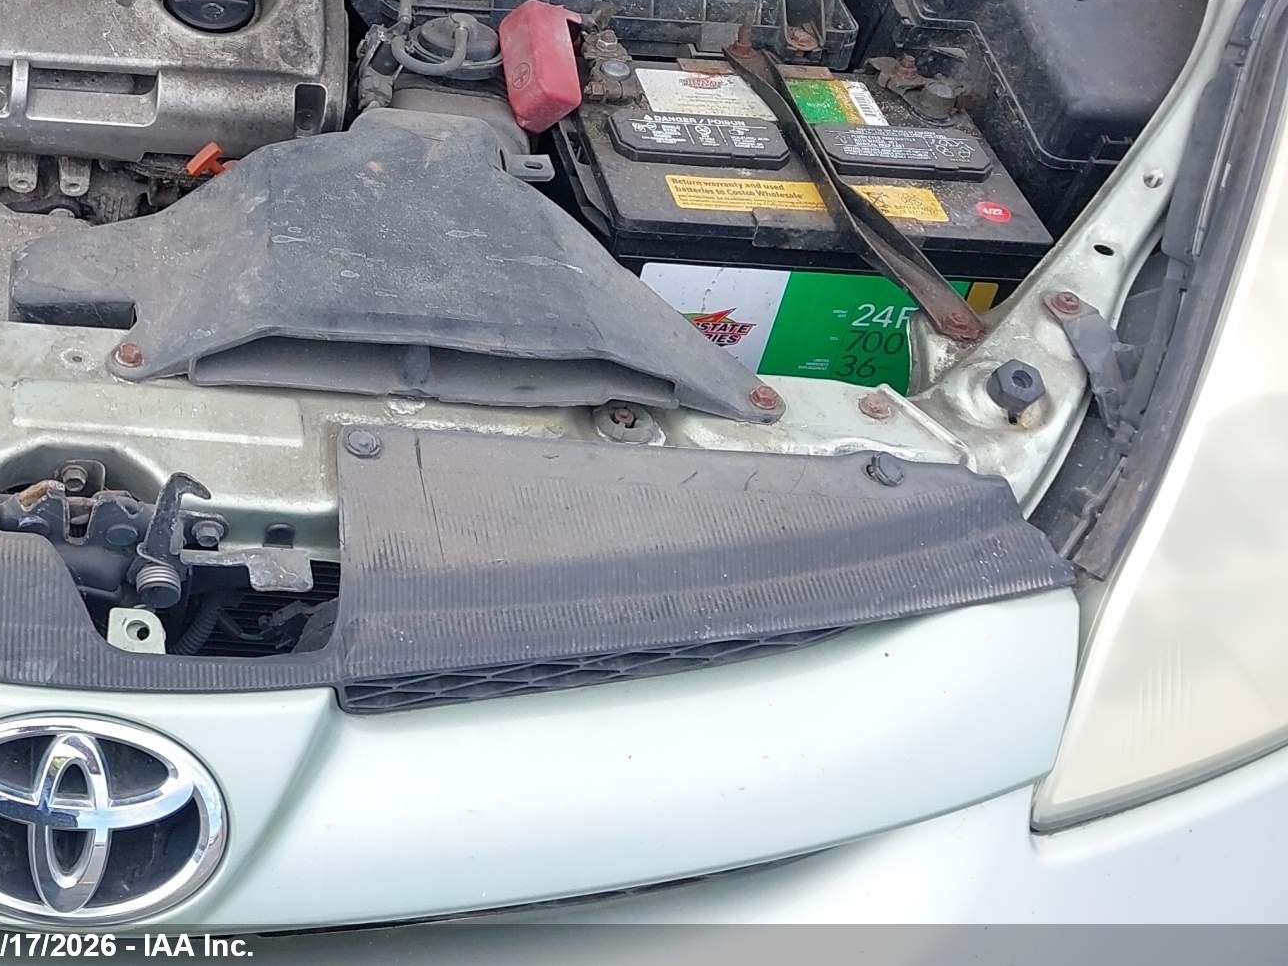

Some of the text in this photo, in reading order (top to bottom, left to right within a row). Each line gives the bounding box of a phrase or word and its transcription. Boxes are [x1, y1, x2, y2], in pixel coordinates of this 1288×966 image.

[654, 115, 697, 124] DANGER
[707, 118, 746, 127] POISON
[671, 178, 785, 191] Return warranty and used
[675, 186, 804, 200] batteries to Costco Wholesale
[696, 321, 751, 334] STATE
[845, 329, 906, 355] 700
